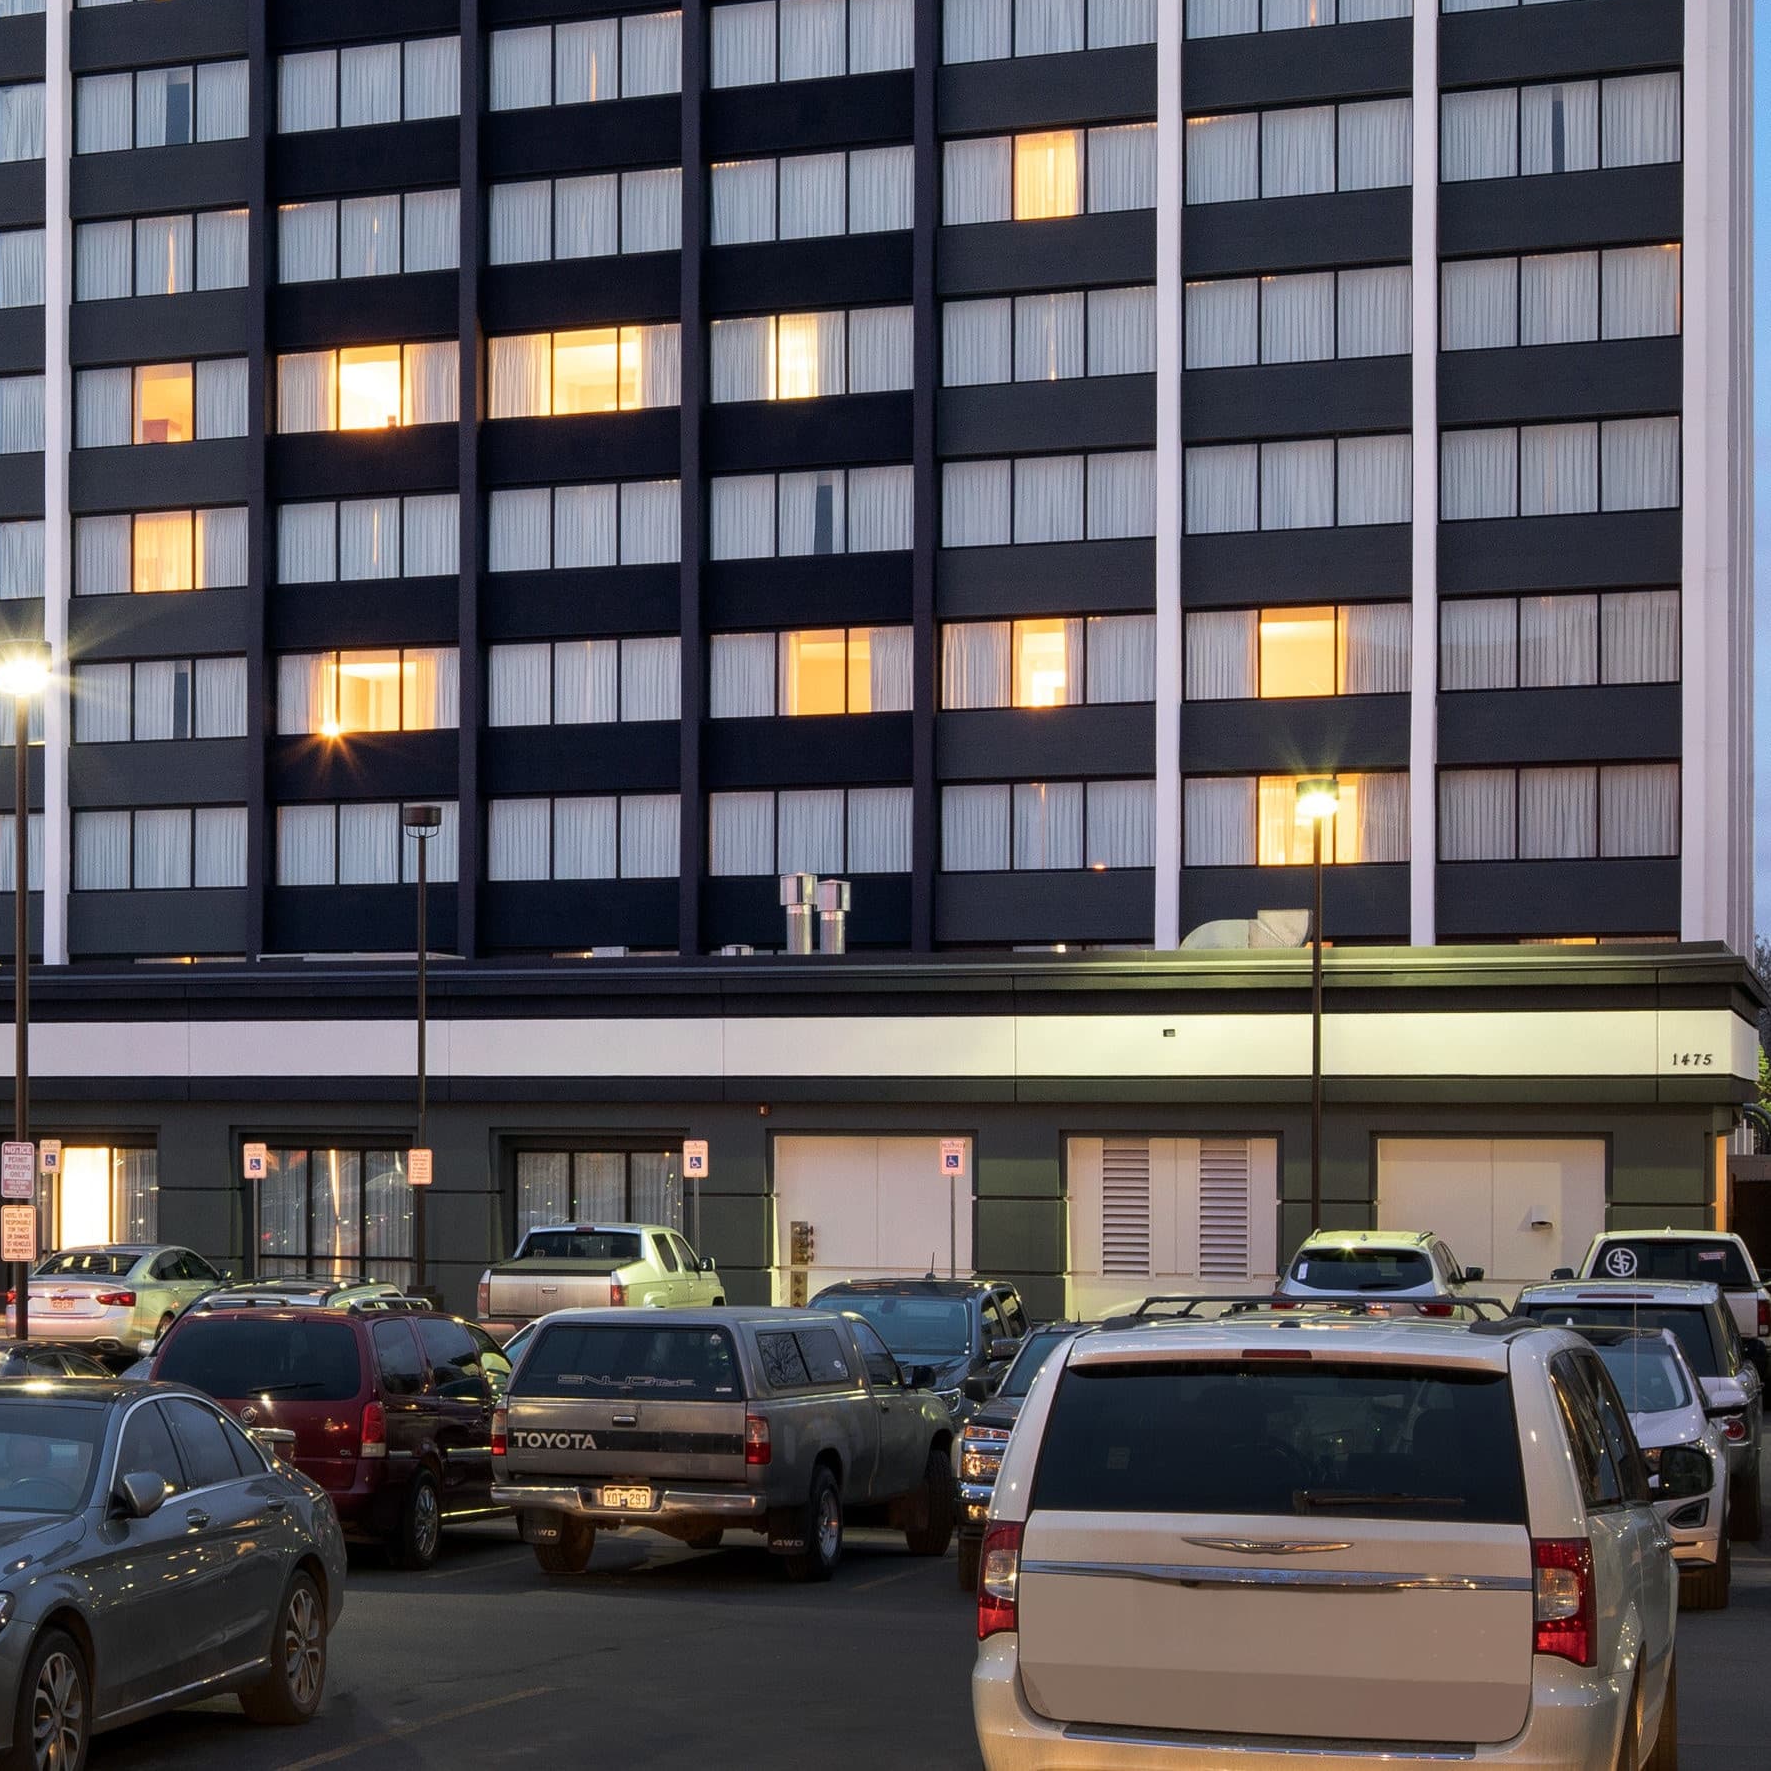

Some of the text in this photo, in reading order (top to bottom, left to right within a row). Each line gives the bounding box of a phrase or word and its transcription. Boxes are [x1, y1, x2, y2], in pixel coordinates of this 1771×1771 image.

[1672, 1052, 1713, 1066] 1475
[4, 1145, 32, 1155] NOTICE
[513, 1432, 597, 1450] TOYOTA
[772, 1539, 804, 1547] 4WD
